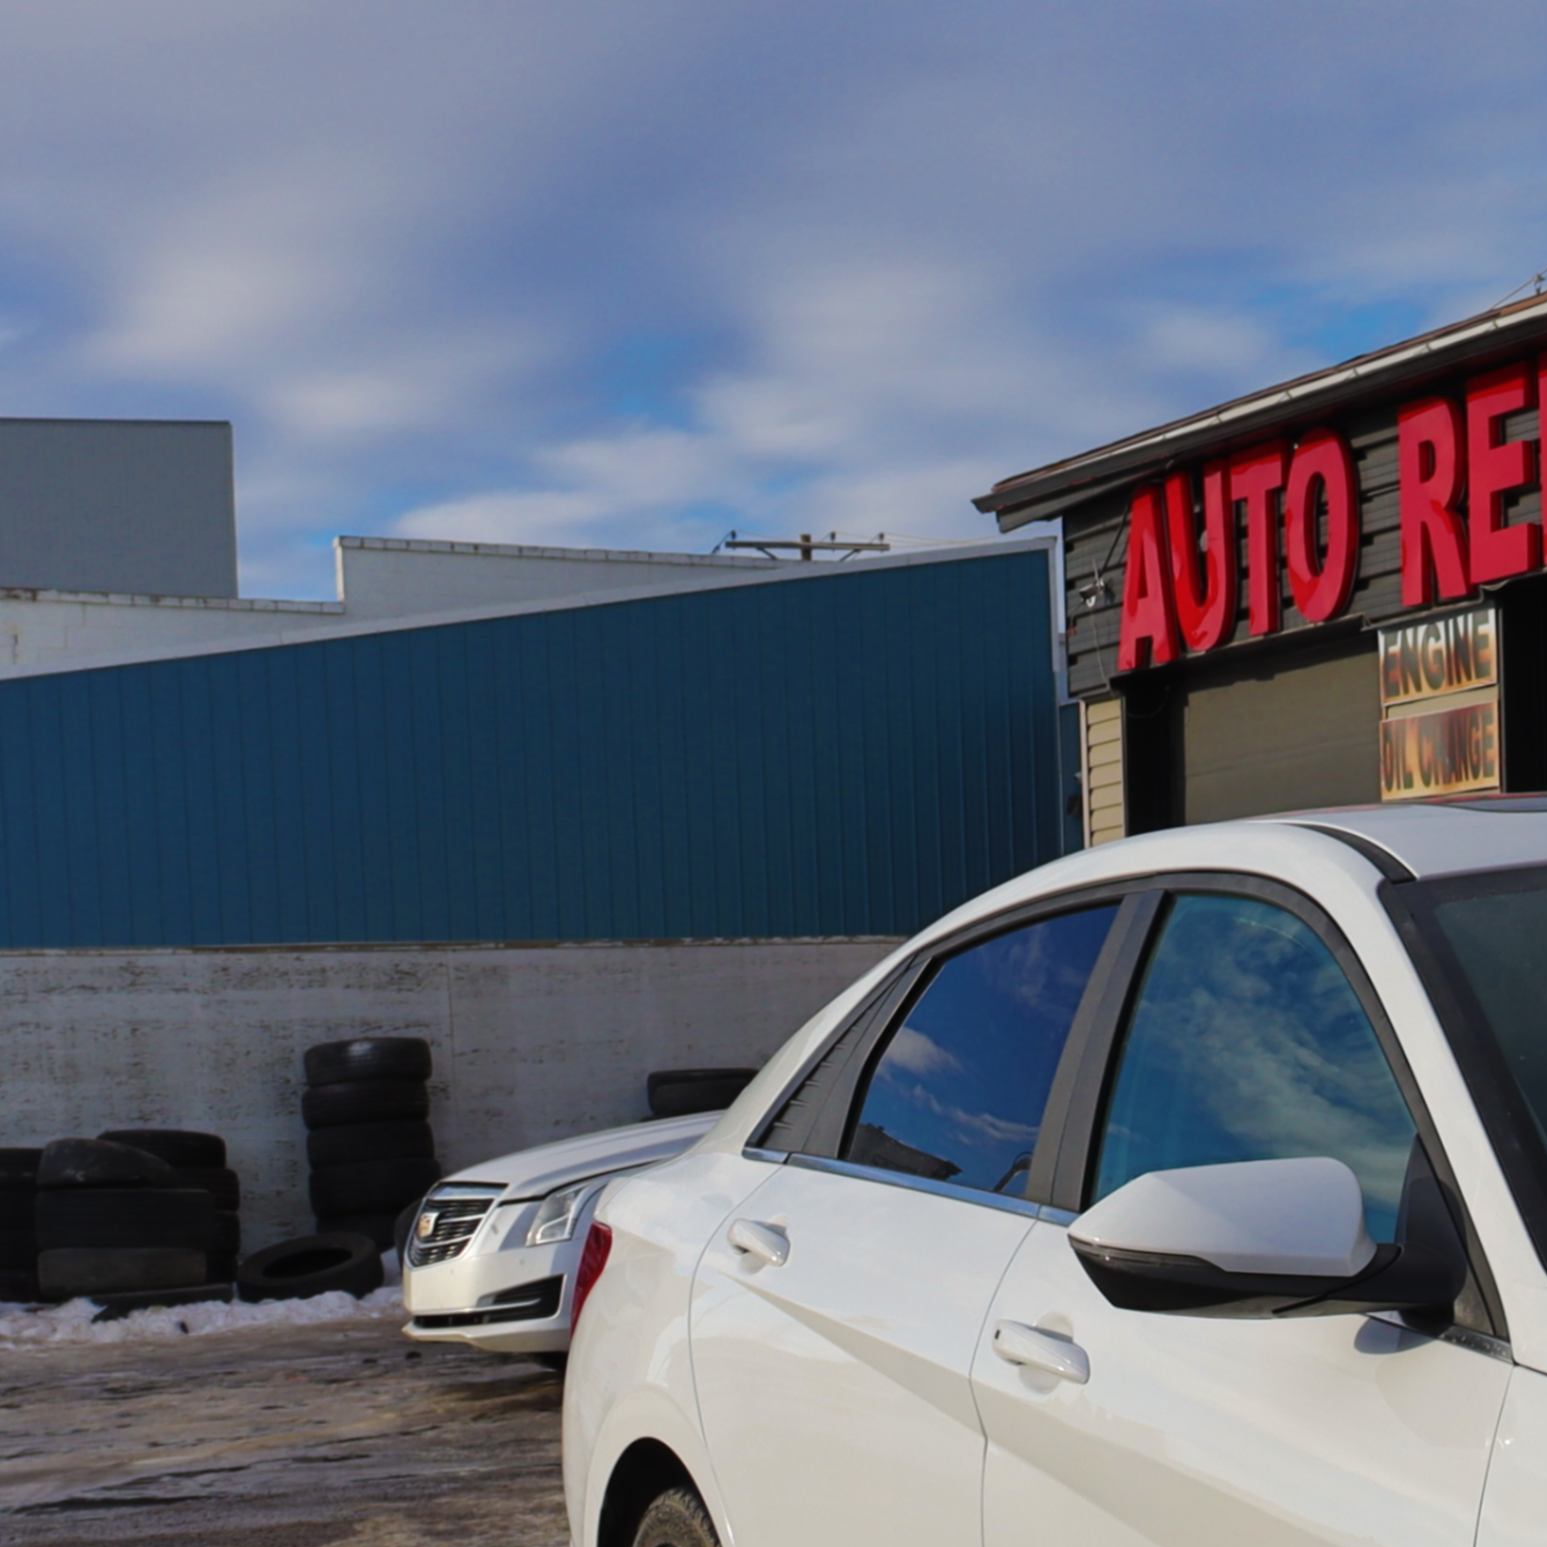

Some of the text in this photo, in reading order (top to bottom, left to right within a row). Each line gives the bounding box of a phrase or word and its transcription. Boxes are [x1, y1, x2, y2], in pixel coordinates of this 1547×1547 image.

[1117, 426, 1361, 672] AUTO
[1383, 611, 1491, 699] ENGINE
[1382, 718, 1415, 793] OIL
